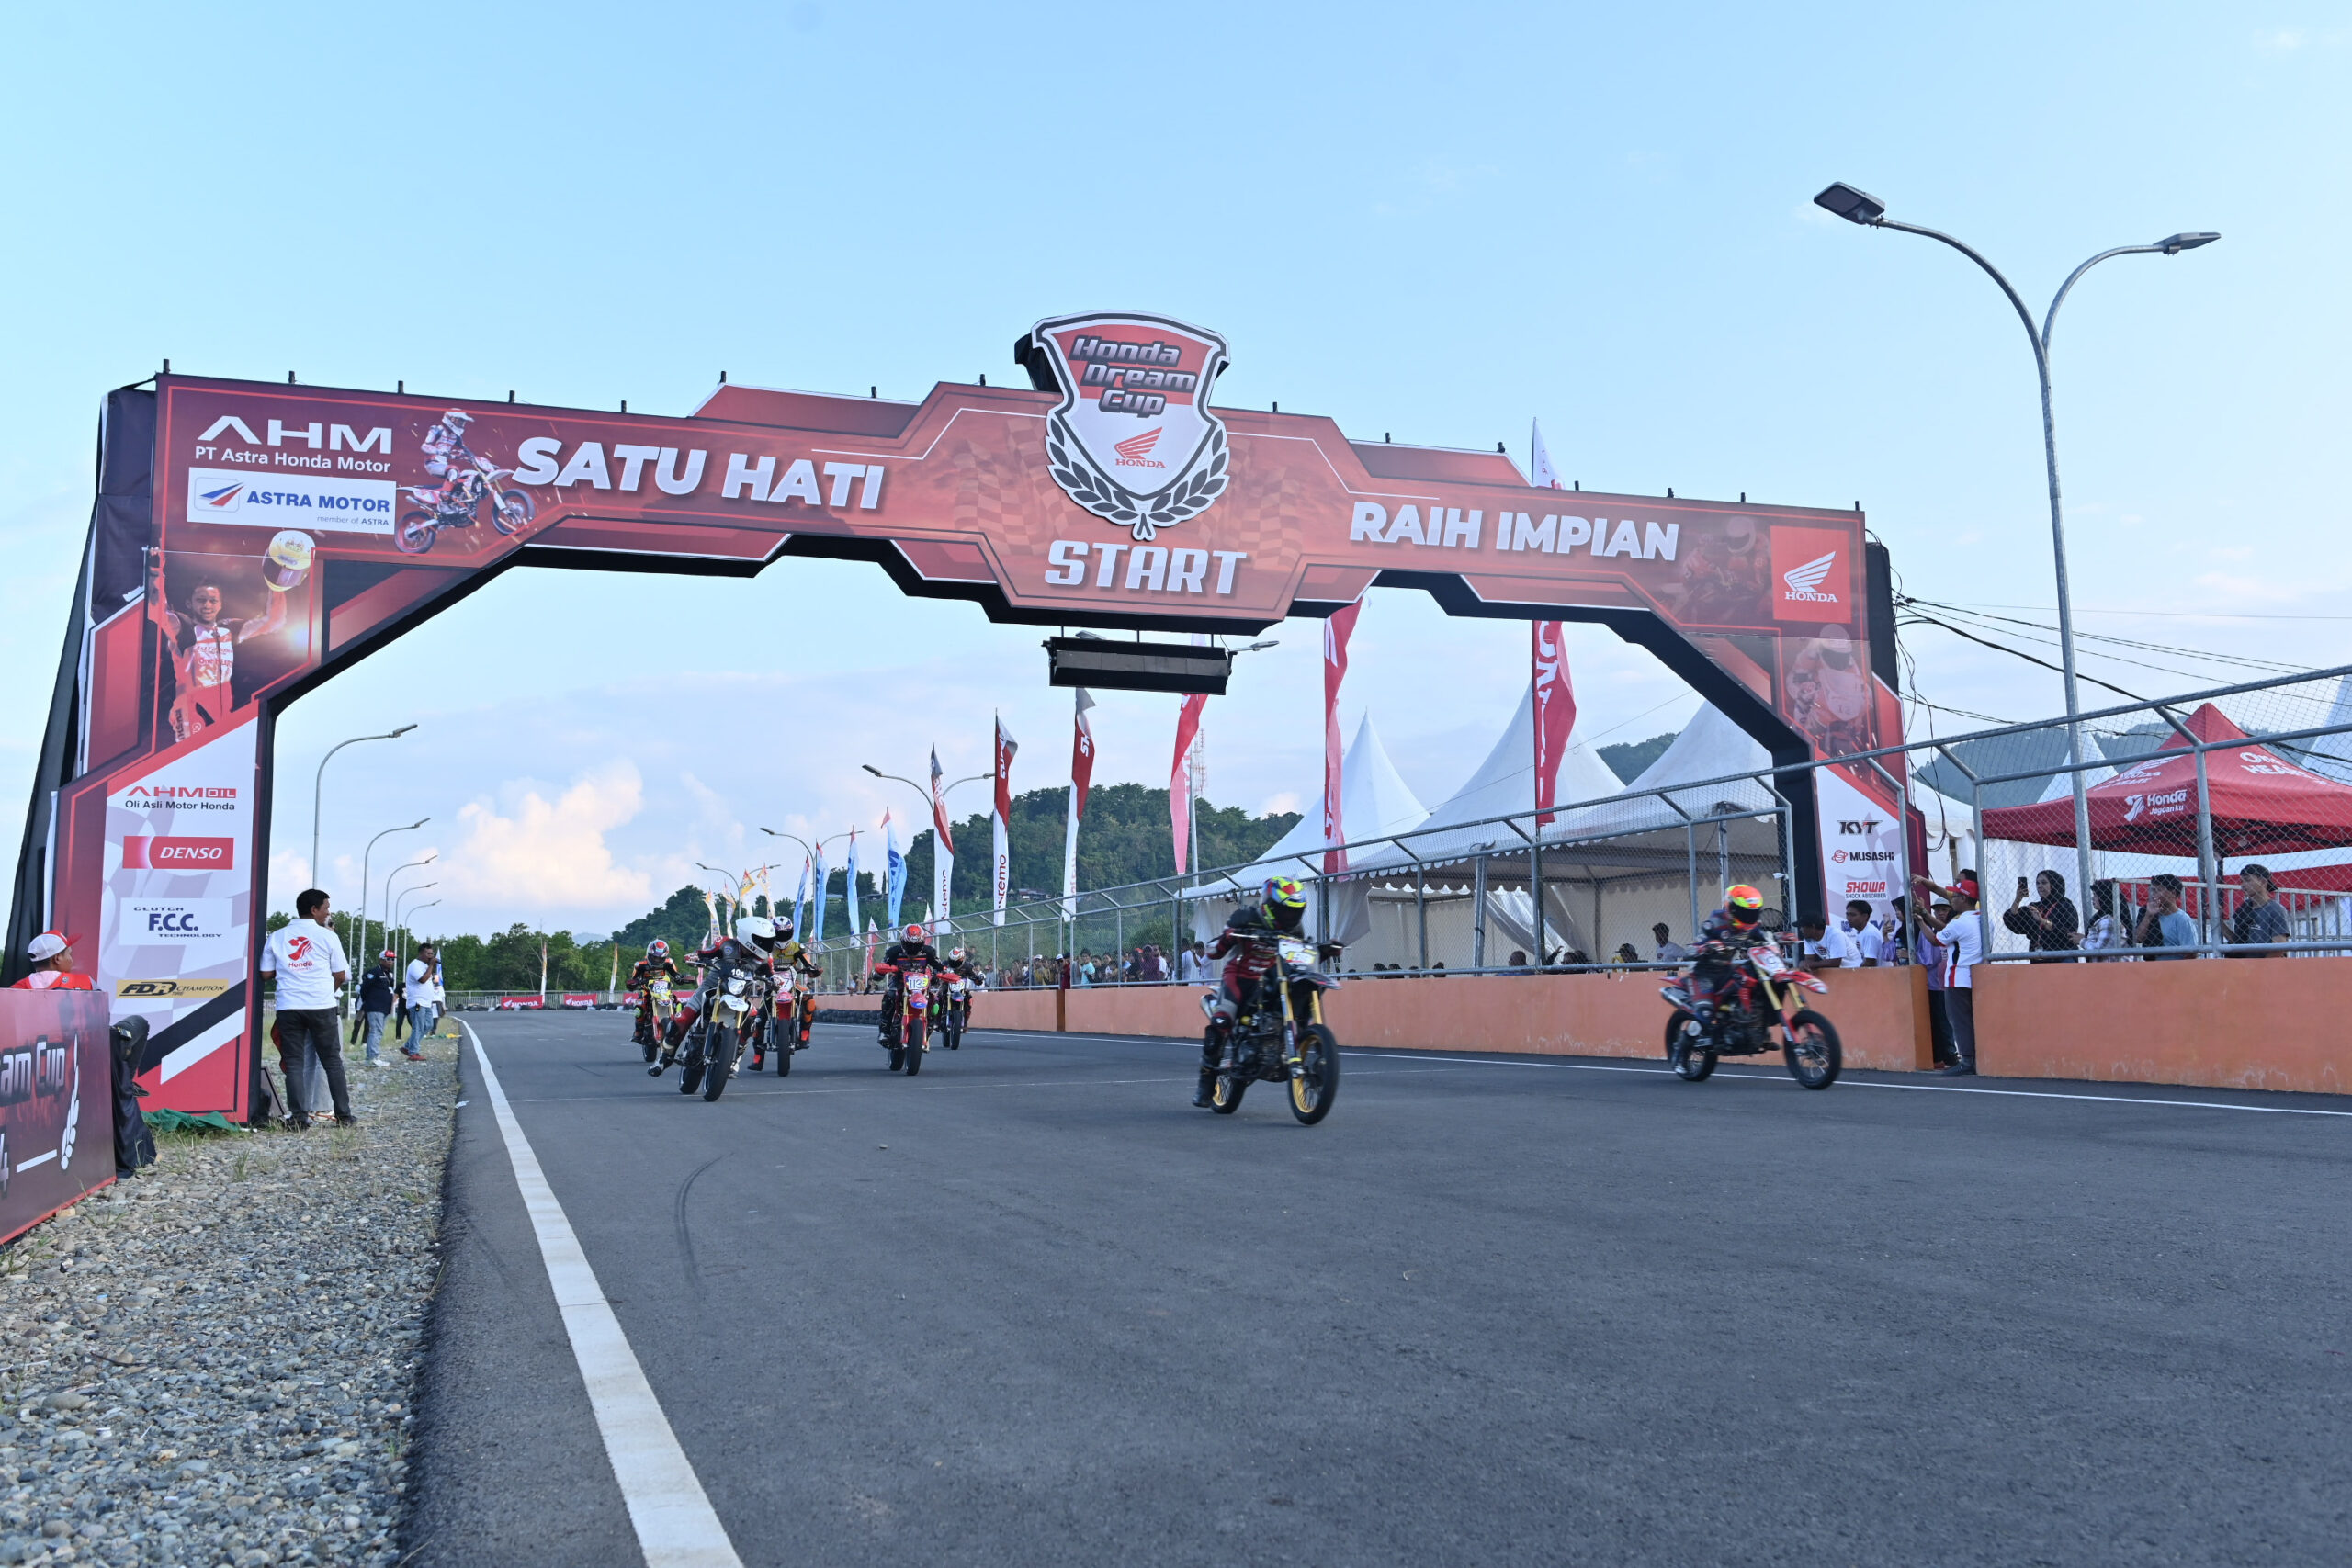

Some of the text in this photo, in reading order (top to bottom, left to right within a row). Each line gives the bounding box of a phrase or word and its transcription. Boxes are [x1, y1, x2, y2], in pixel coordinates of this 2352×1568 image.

[1070, 336, 1181, 366] Honda
[1082, 363, 1197, 391] Dream
[1102, 389, 1165, 415] Cup
[197, 415, 392, 455] AHM
[195, 446, 390, 473] PT Astra Honda Motor
[1114, 458, 1166, 468] HONDA
[511, 436, 885, 509] SATU HATI
[246, 491, 390, 513] ASTRA MOTOR
[317, 515, 389, 526] member of ASTRA
[1350, 501, 1679, 561] RAIH IMPIAN
[1045, 540, 1248, 594] START
[1785, 591, 1838, 603] HONDA
[125, 800, 235, 810] Oli Asli Motor Honda
[2147, 789, 2188, 807] Honda
[1838, 819, 1883, 836] KYT
[160, 846, 222, 859] DENSO
[1845, 882, 1886, 893] SHOWA
[149, 913, 198, 931] F.C.C.
[119, 981, 177, 996] FDR
[36, 1041, 66, 1090] Cup
